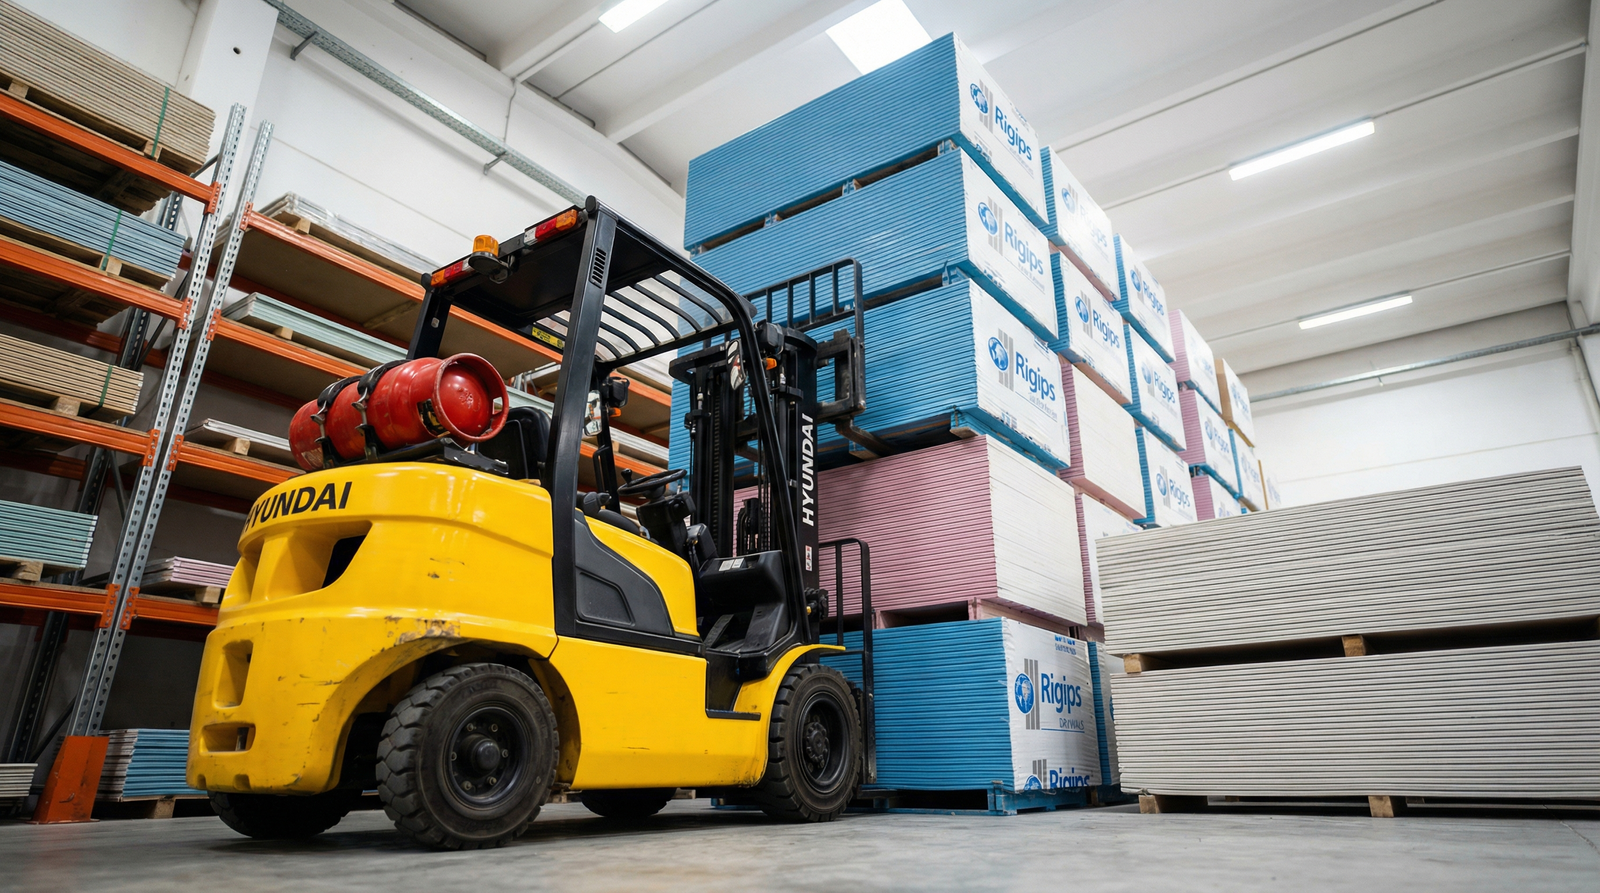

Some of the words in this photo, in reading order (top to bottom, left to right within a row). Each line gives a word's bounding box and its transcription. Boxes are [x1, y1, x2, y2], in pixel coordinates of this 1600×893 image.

[995, 105, 1033, 161] Rigips
[1004, 221, 1044, 276] Rigips
[1092, 308, 1120, 349] Rigips
[1015, 351, 1056, 402] Rigips
[801, 412, 815, 527] HYUNDAI
[244, 481, 353, 533] HYUNDAI
[1041, 672, 1082, 714] Rigips
